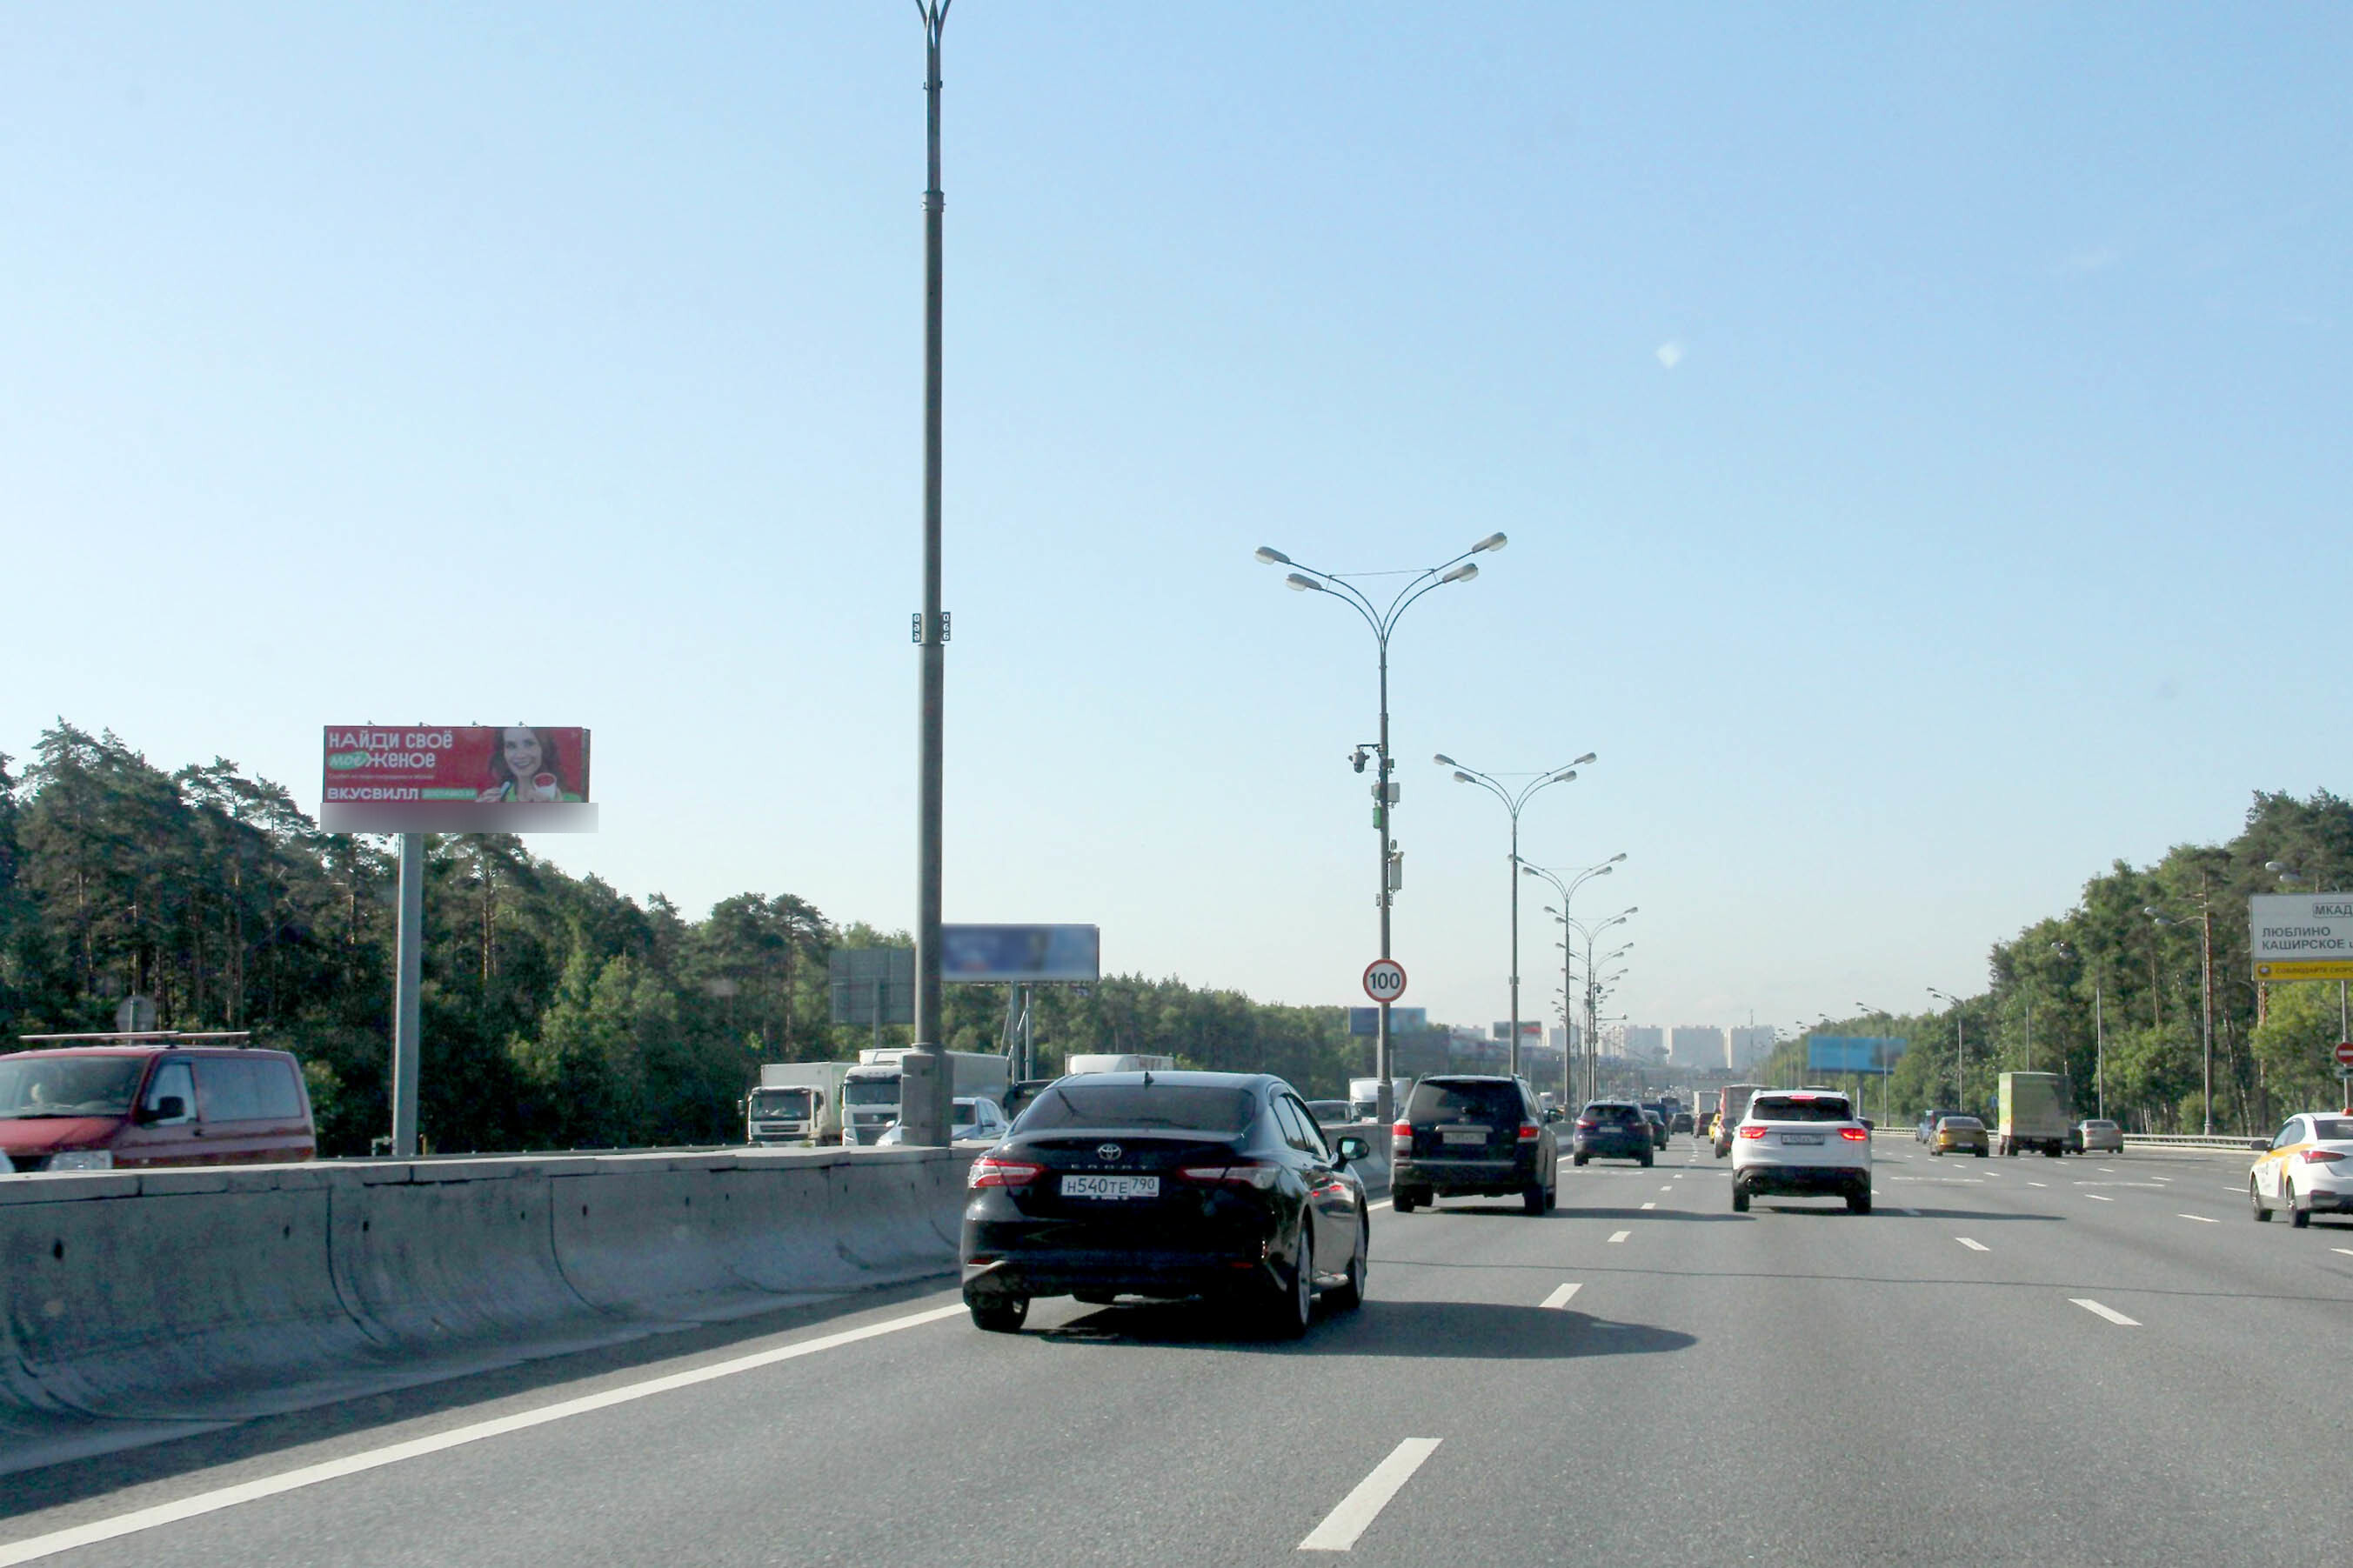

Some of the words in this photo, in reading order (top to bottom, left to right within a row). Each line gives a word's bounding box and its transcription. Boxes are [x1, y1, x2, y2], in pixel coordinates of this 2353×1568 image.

[329, 730, 399, 751] НАЙДИ
[327, 787, 419, 800] ВКУСВИЛЛ
[2315, 905, 2353, 916] МКАД
[2263, 927, 2331, 937] ЛЮБЛИНО
[2263, 939, 2345, 951] КАШИРСКОЕ
[1369, 972, 1400, 990] 100
